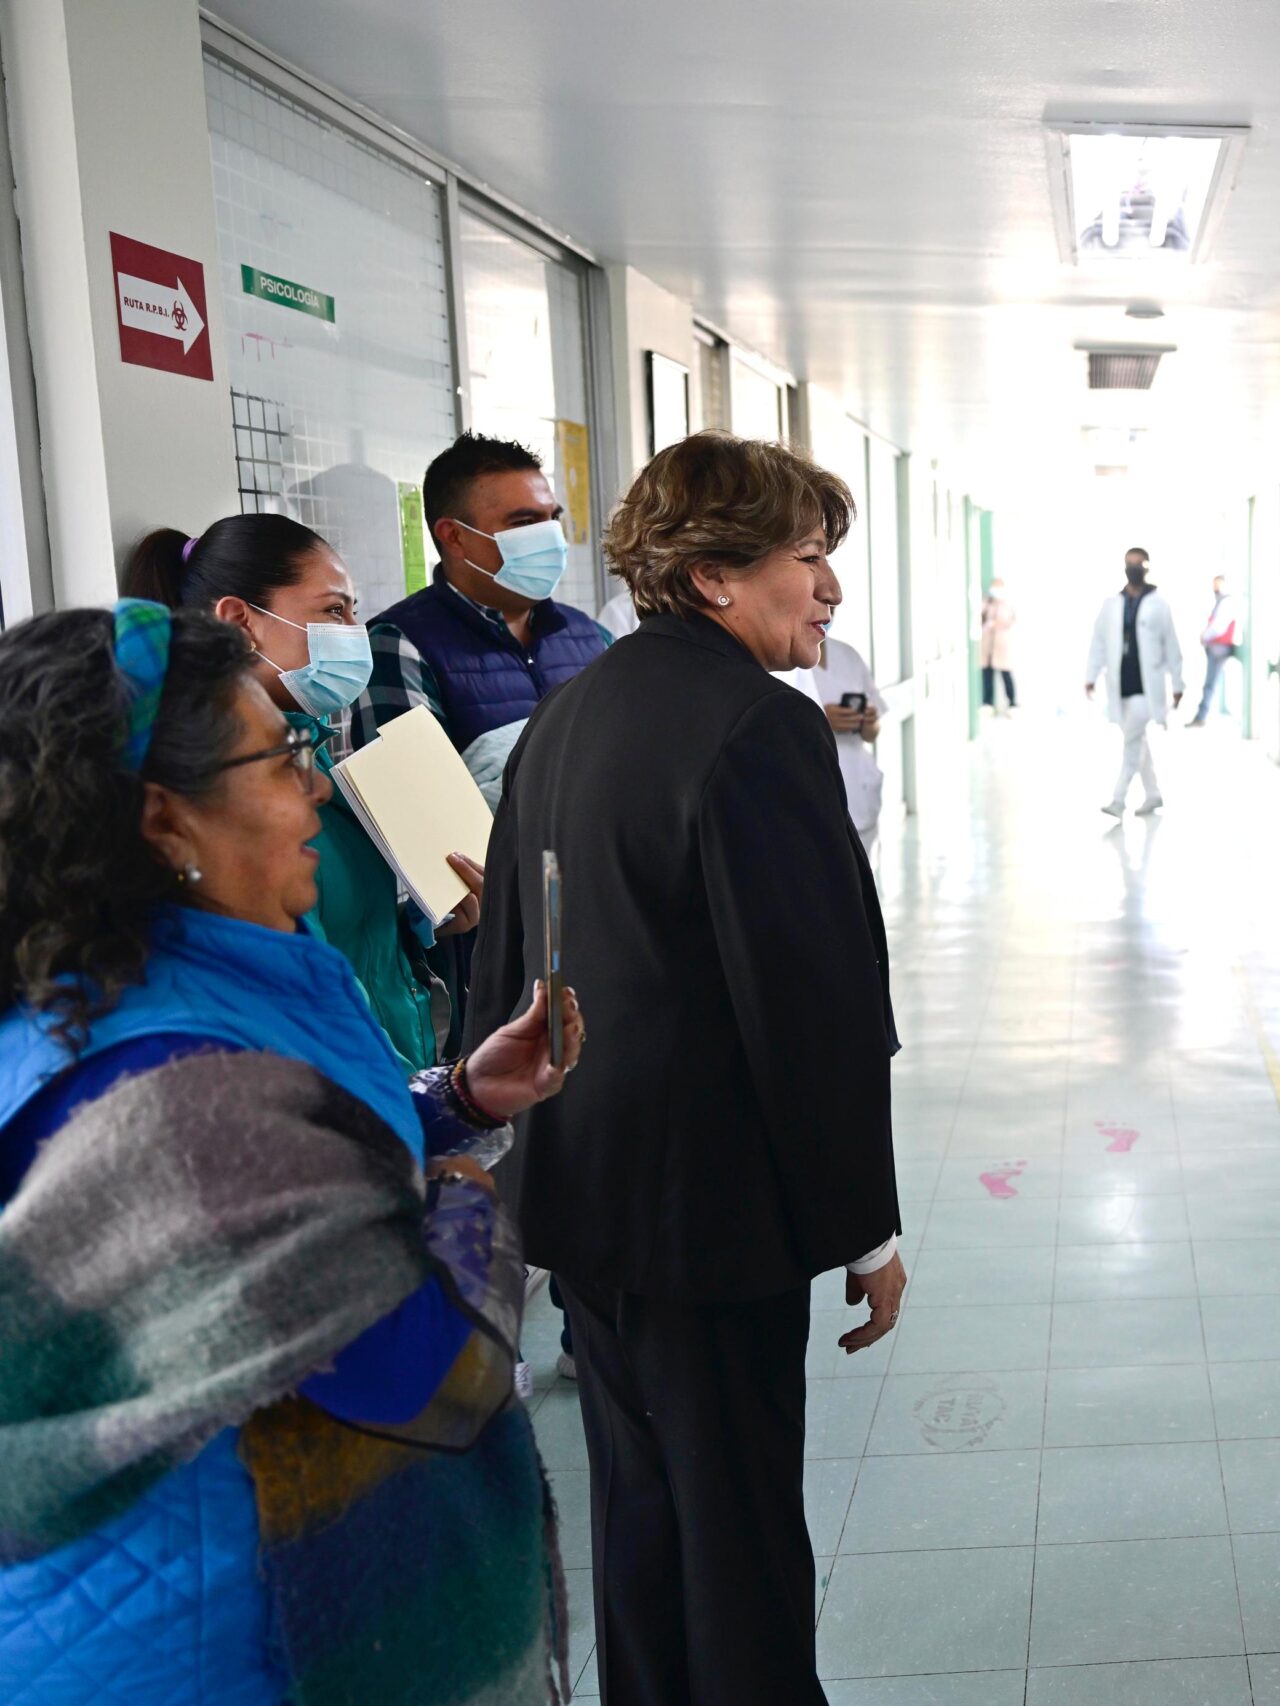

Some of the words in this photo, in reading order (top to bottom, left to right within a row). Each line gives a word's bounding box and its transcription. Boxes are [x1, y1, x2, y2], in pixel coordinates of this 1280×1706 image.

[260, 276, 319, 308] PSICOLOGÍA
[123, 296, 144, 310] RUTA
[145, 303, 170, 317] R.P.B.I.
